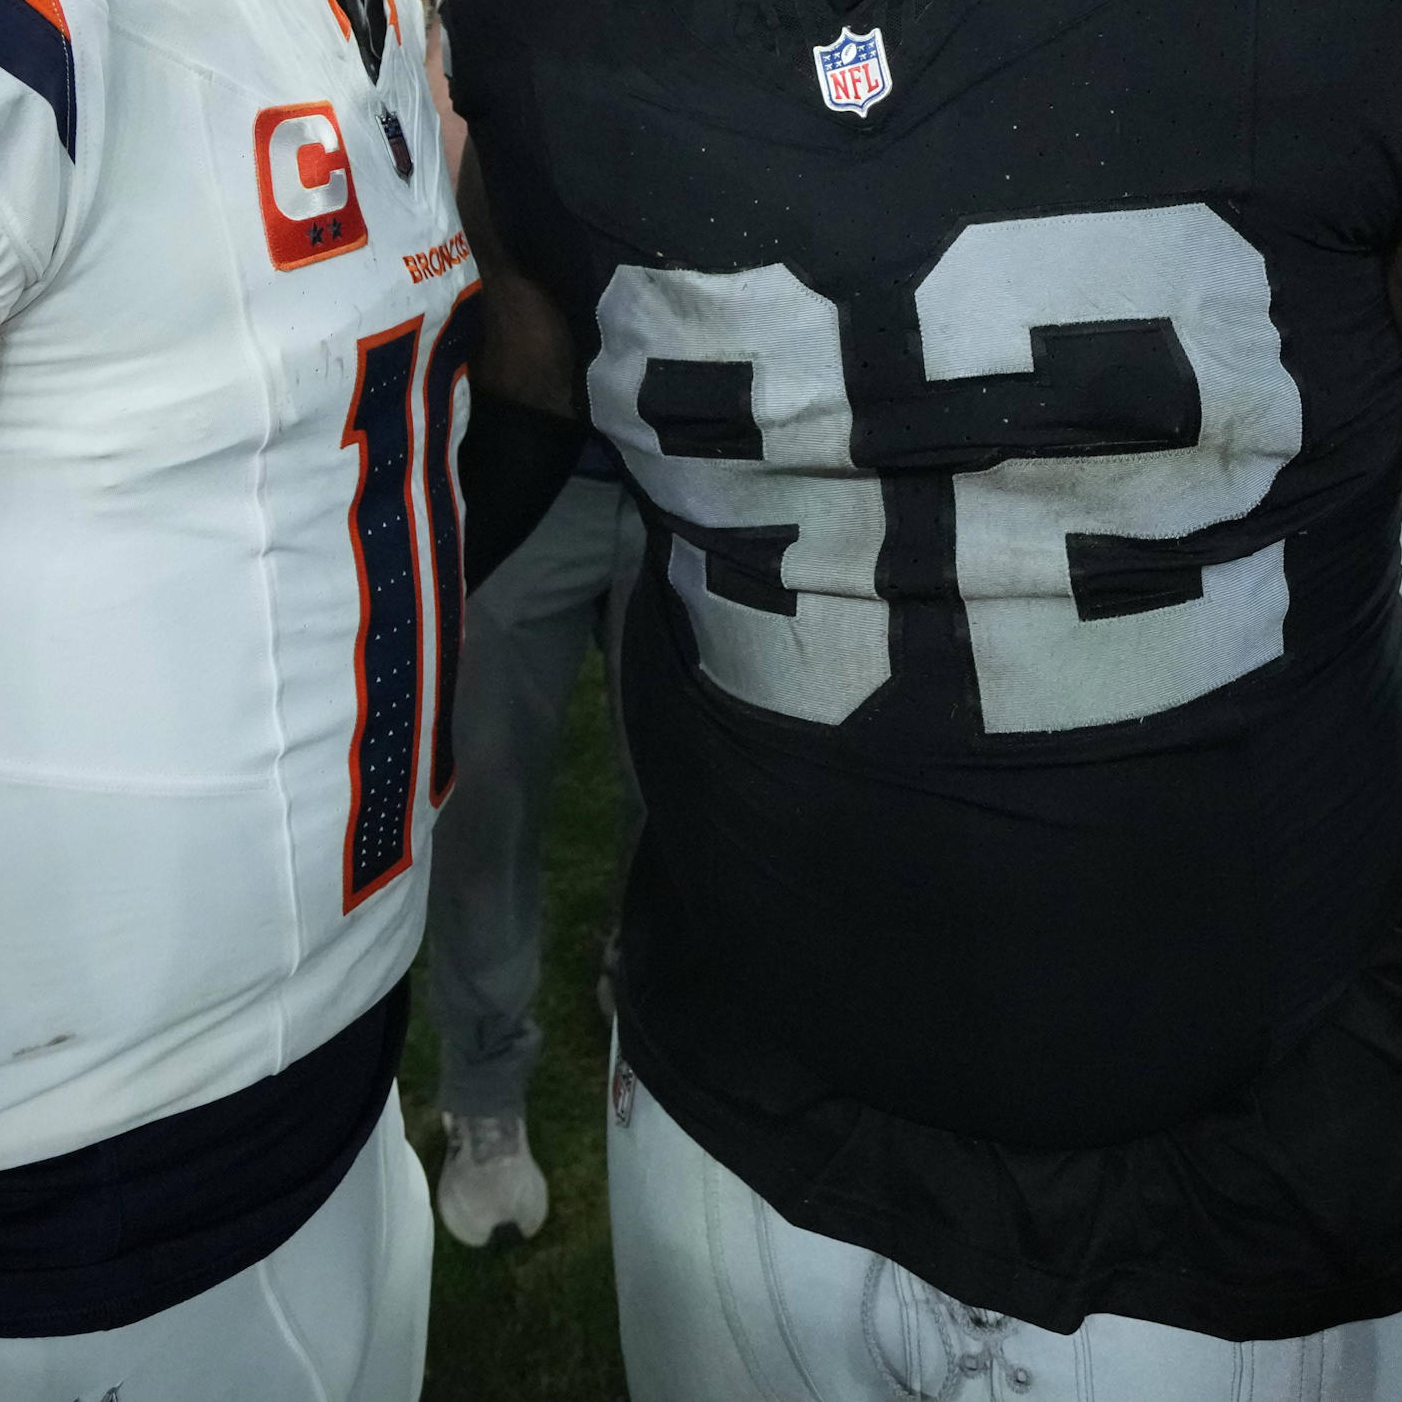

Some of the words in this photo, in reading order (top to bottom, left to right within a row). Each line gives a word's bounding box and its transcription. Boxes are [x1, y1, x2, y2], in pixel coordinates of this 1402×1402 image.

[269, 113, 350, 223] C
[829, 62, 880, 100] NFL
[340, 280, 483, 917] 10
[587, 202, 1303, 735] 92
